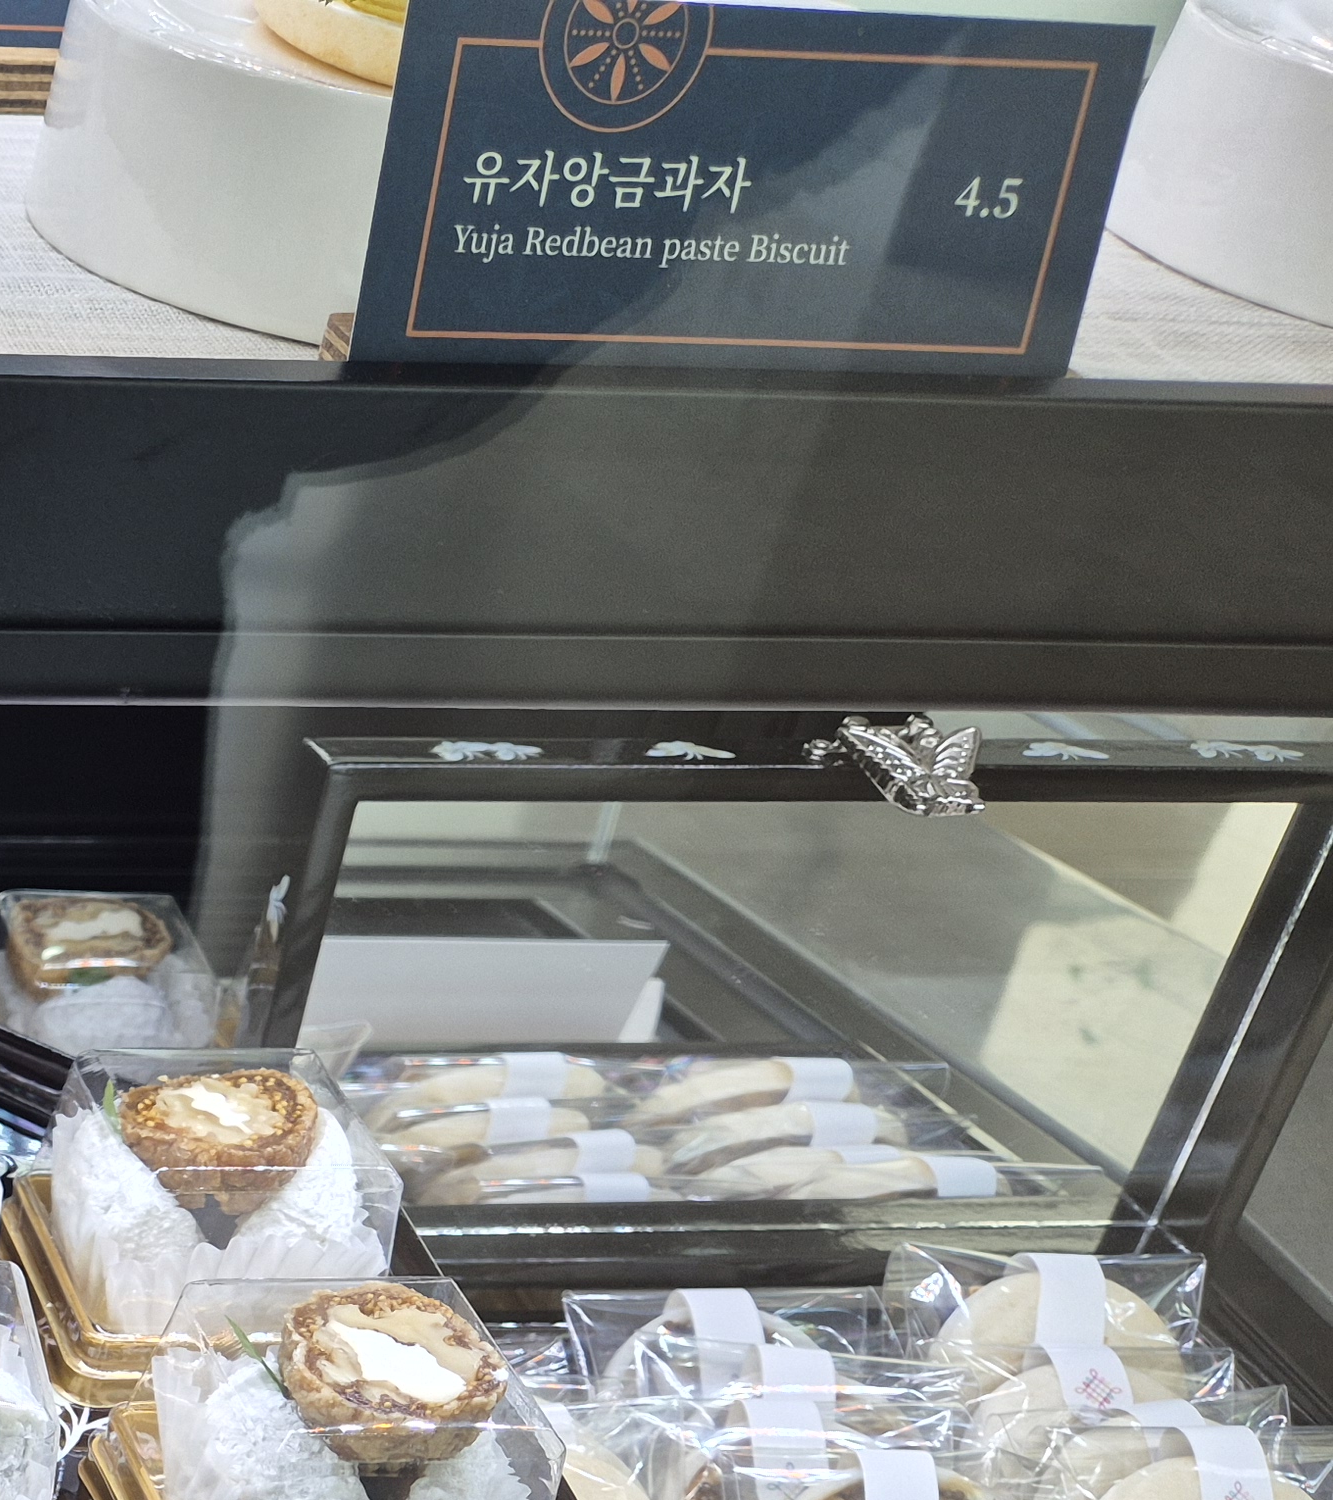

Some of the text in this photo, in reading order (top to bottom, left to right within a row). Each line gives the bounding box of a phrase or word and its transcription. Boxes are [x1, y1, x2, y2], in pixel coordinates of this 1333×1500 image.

[463, 149, 752, 214] 유자앙금과자
[954, 176, 1023, 219] 4.5
[454, 223, 850, 268] Yuja Redbean paste Biscuit
